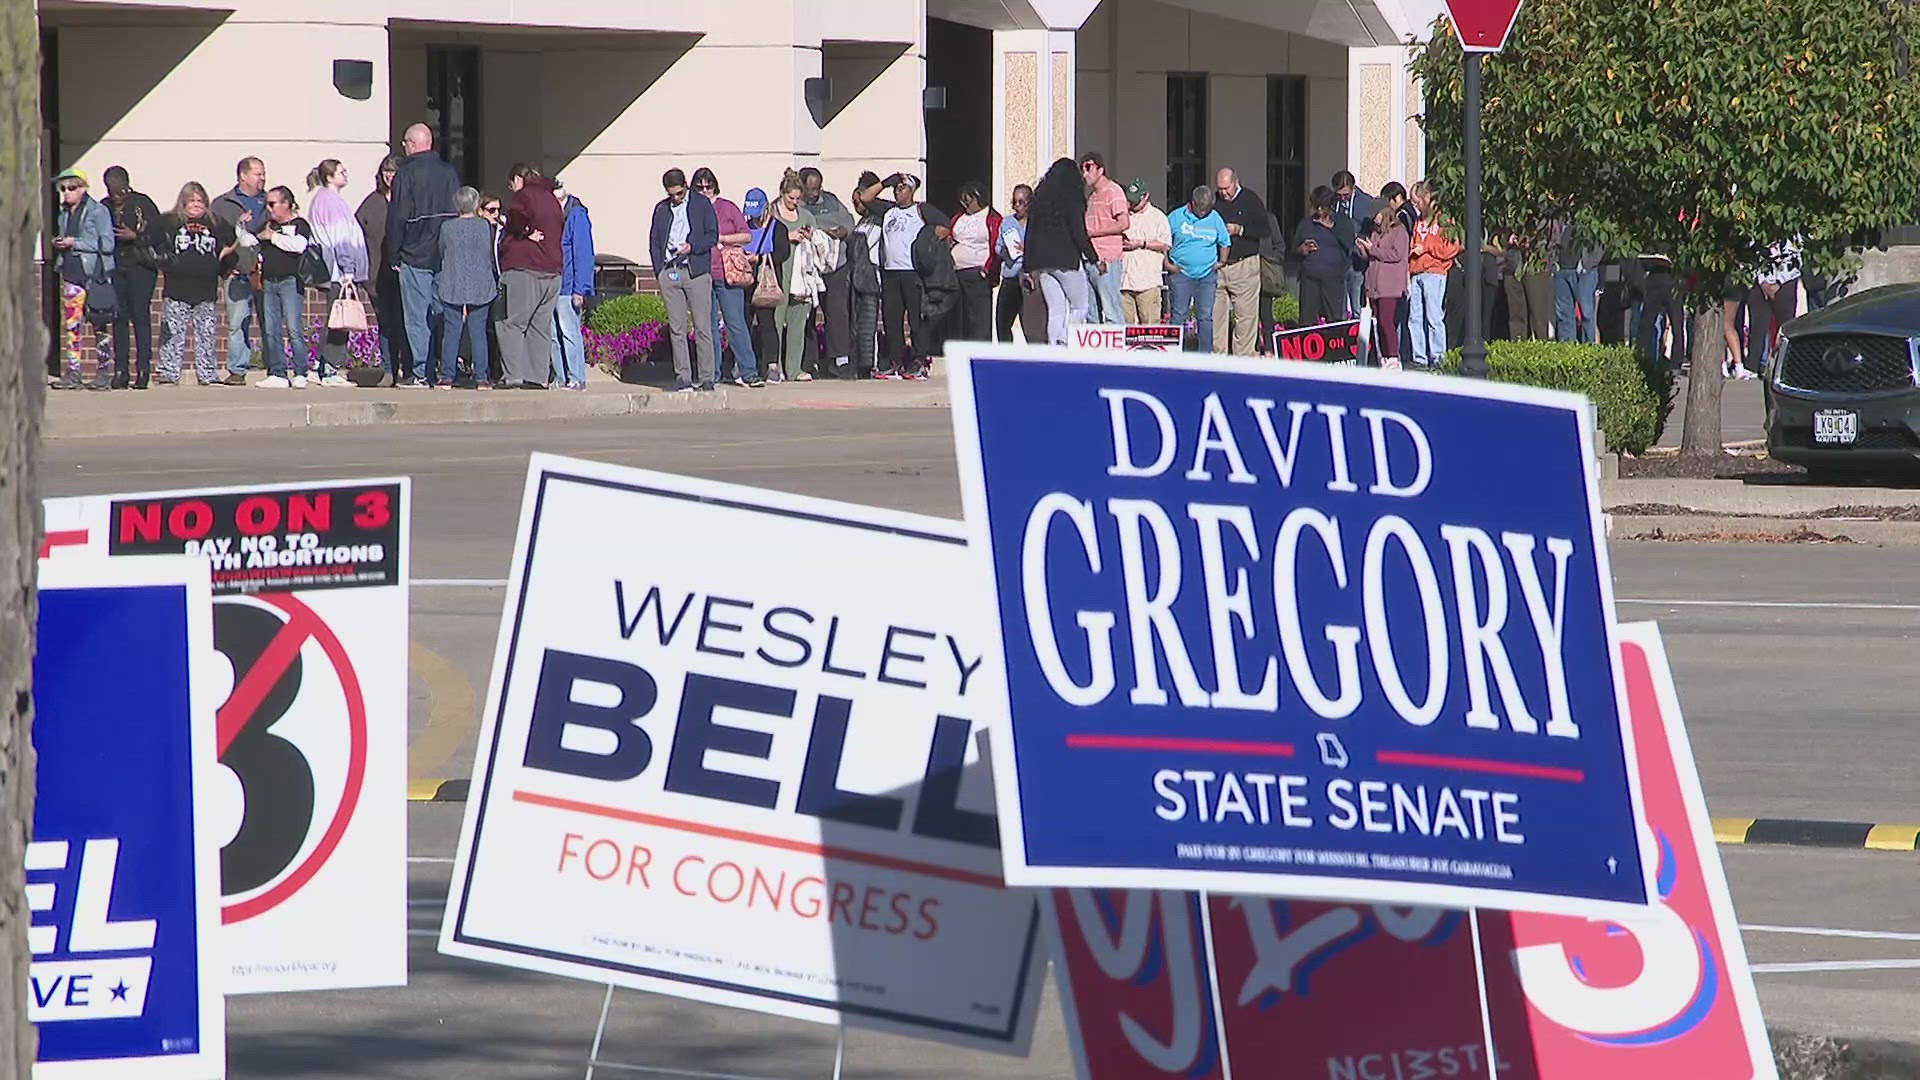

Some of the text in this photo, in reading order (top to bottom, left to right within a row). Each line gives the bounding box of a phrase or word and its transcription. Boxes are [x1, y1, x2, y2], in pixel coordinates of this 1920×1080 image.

[1077, 329, 1123, 349] VOTE
[1281, 332, 1325, 360] NO
[1329, 337, 1345, 349] ON
[1098, 387, 1434, 498] DAVID
[119, 490, 391, 543] NO ON 3
[240, 535, 278, 553] NO
[286, 532, 319, 550] TO
[247, 545, 384, 568] ABORTIONS
[613, 579, 983, 697] WESLEY
[1021, 492, 1580, 738] GREGORY
[522, 647, 1003, 850] BELL
[1152, 769, 1525, 845] STATE SENATE
[557, 833, 942, 942] FOR CONGRESS
